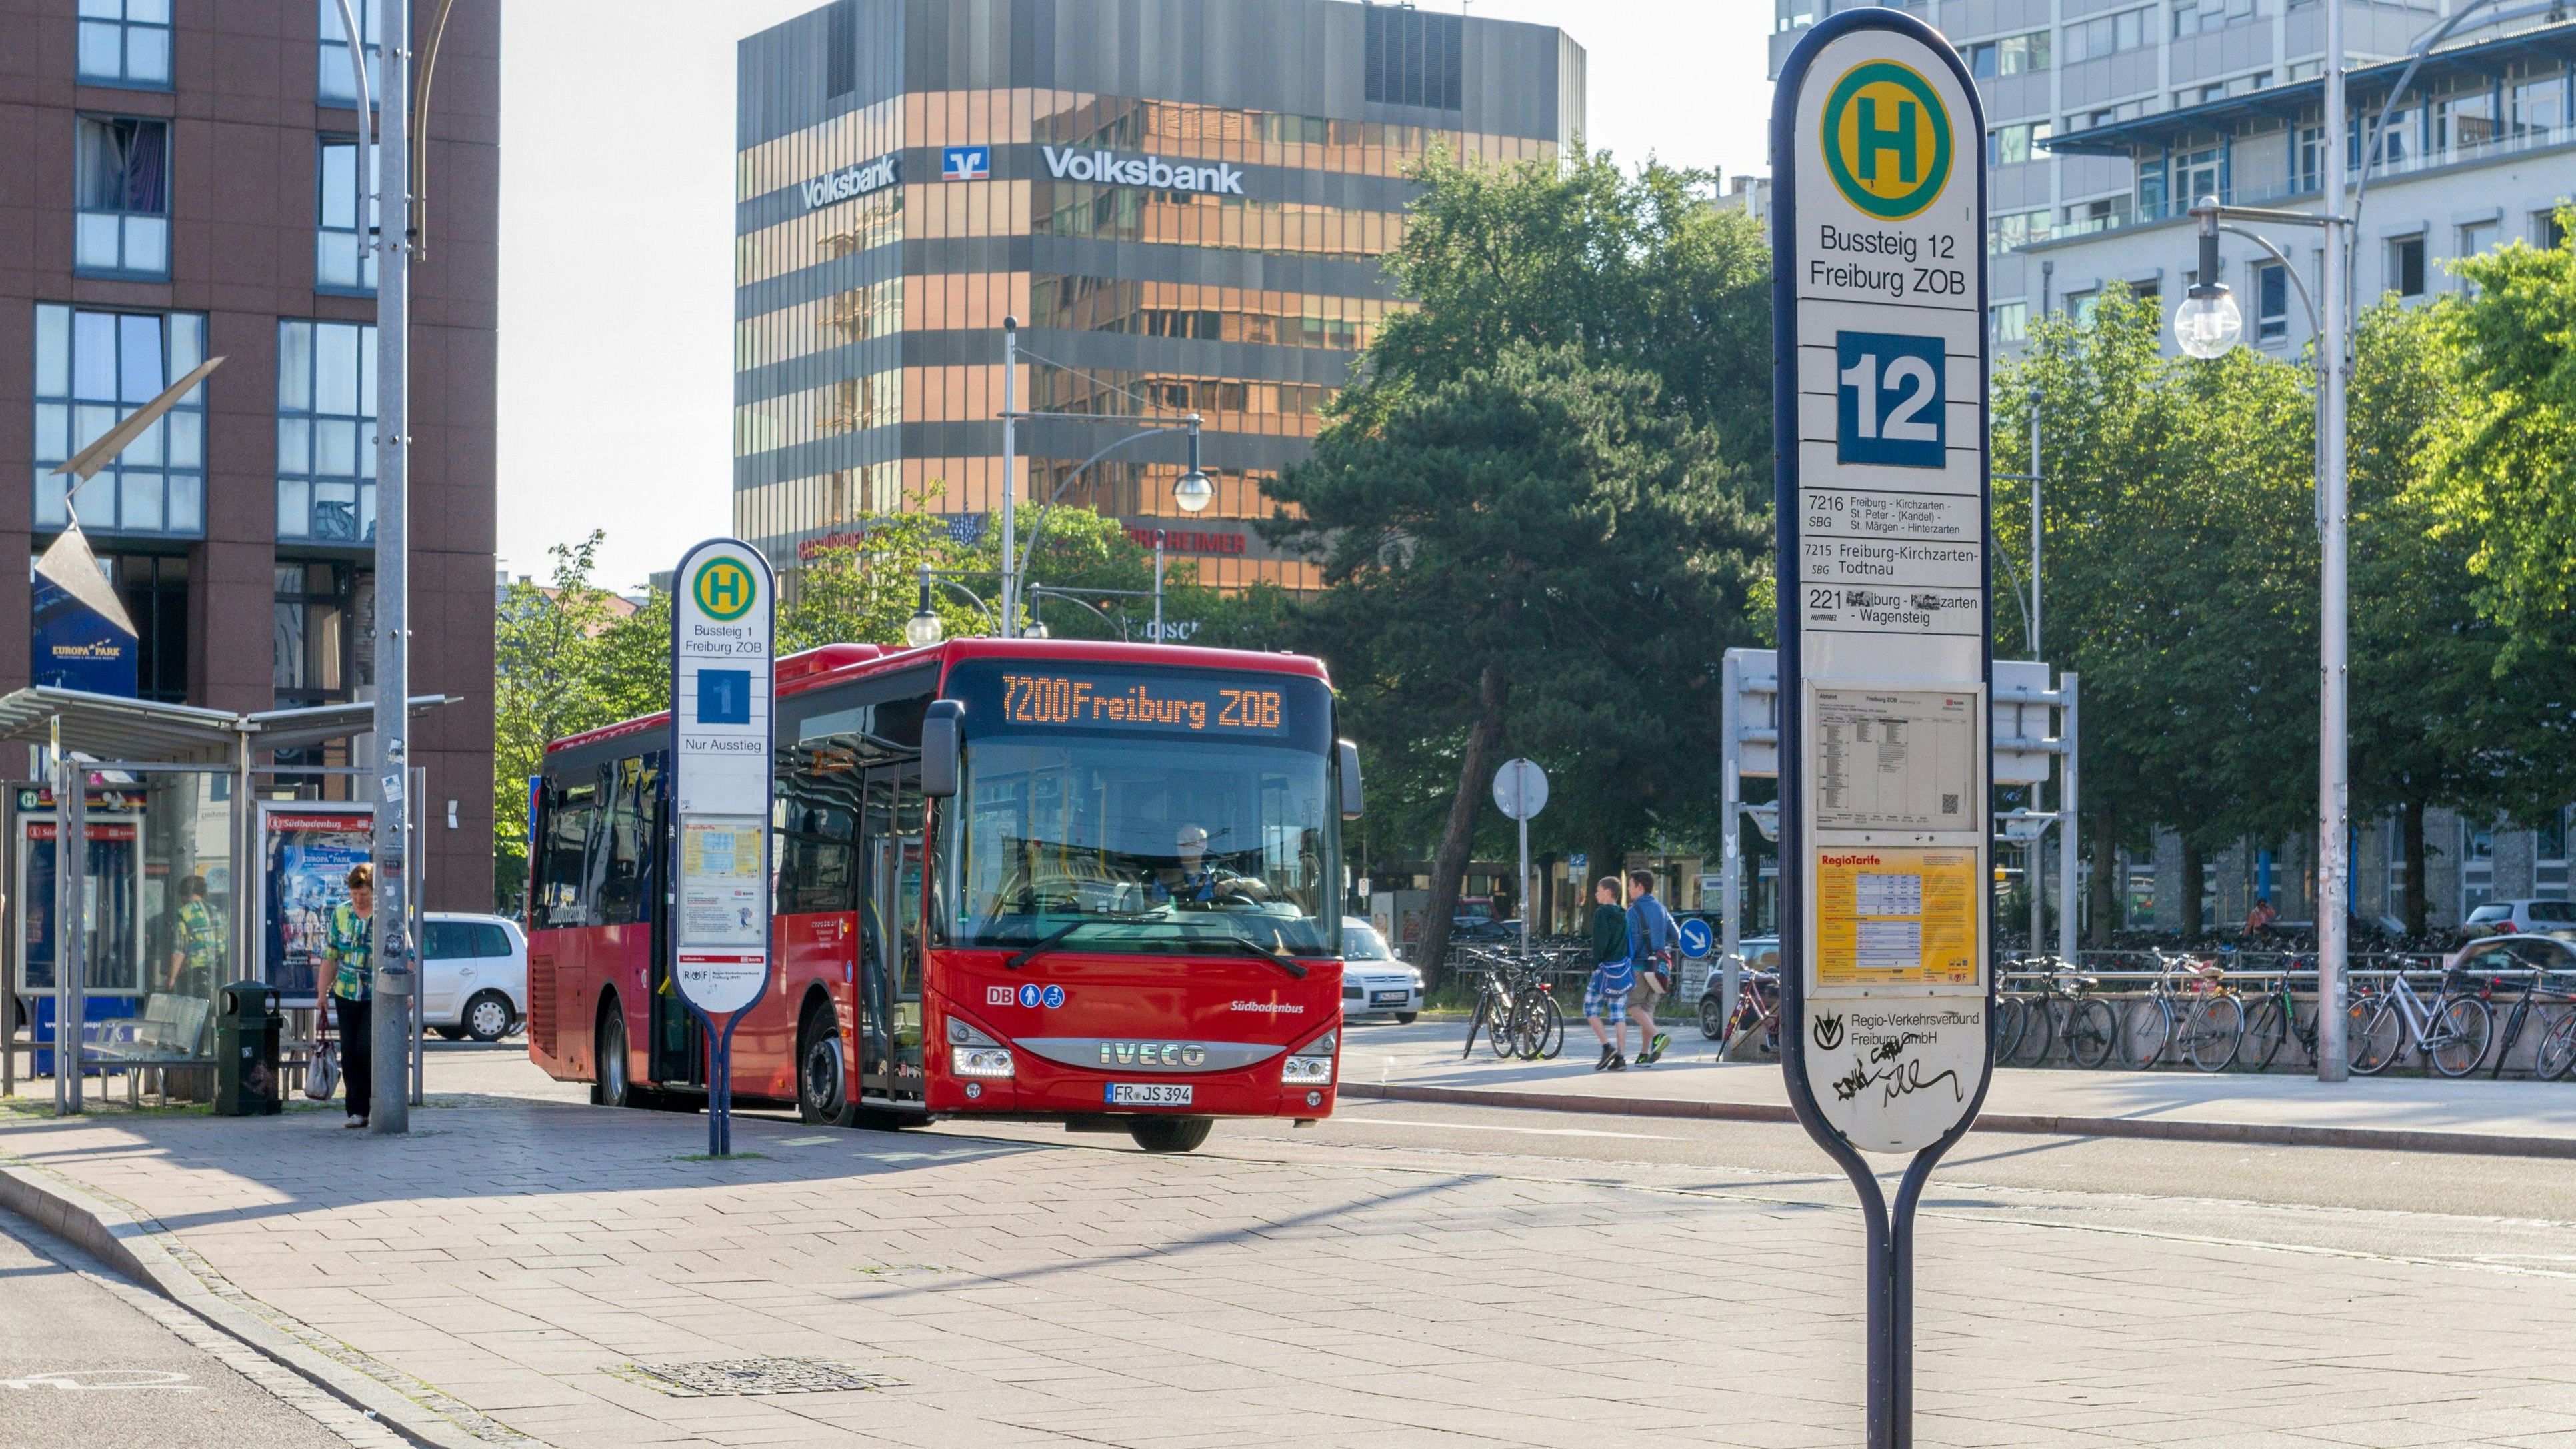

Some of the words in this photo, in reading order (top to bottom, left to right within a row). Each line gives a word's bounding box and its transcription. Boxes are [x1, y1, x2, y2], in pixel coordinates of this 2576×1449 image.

[1857, 97, 1917, 183] H
[1043, 145, 1243, 195] Volksbank
[801, 155, 895, 209] Volksbank
[1821, 225, 1917, 263] Bussteig
[1929, 234, 1955, 259] 12
[1811, 260, 1903, 297] Freiburg
[1913, 268, 1965, 295] ZOB
[1841, 353, 1937, 441] 12
[1809, 495, 1844, 511] 7216
[1851, 497, 1887, 509] Freiburg
[1896, 499, 1945, 511] Kirchzarten
[1809, 517, 1832, 527] SBG
[1851, 509, 1862, 519] St.
[1865, 509, 1889, 520] Peter
[1898, 511, 1935, 523] (Kandel)
[1851, 521, 1862, 531] St.
[1865, 521, 1898, 533] Märgen
[1907, 525, 1960, 534] Hinterzarten
[1805, 545, 1832, 556] 7215
[1840, 543, 1978, 562] Freiburg-Kirchzarten-
[1811, 565, 1829, 575] SBG
[1839, 561, 1893, 575] Todtnau
[710, 572, 739, 607] H
[1809, 589, 1842, 609] 221
[1860, 610, 1930, 625] Wagensteig
[695, 625, 742, 639] Bussteig
[747, 627, 752, 637] 1
[52, 646, 89, 656] EUROPA
[95, 647, 120, 657] PARK
[685, 641, 731, 655] Freiburg
[736, 641, 762, 653] ZOB
[713, 678, 731, 714] 1
[1219, 689, 1281, 728] ZOB
[685, 739, 707, 750] Nur
[711, 740, 761, 752] Ausstieg
[283, 818, 341, 828] Südbadenbus
[1822, 855, 1881, 867] RegioTarife
[548, 899, 587, 924] Südbadenbus
[989, 988, 1013, 1004] DB
[1231, 1000, 1304, 1014] Südbadenbus
[1851, 1012, 1979, 1030] Regio-Verkehrsverbund
[1851, 1032, 1897, 1047] Freiburg
[1901, 1032, 1937, 1044] GmbH
[1100, 1042, 1205, 1067] IVECO
[1115, 1086, 1133, 1100] FR
[1143, 1086, 1161, 1101] JS
[1164, 1087, 1189, 1102] 394
